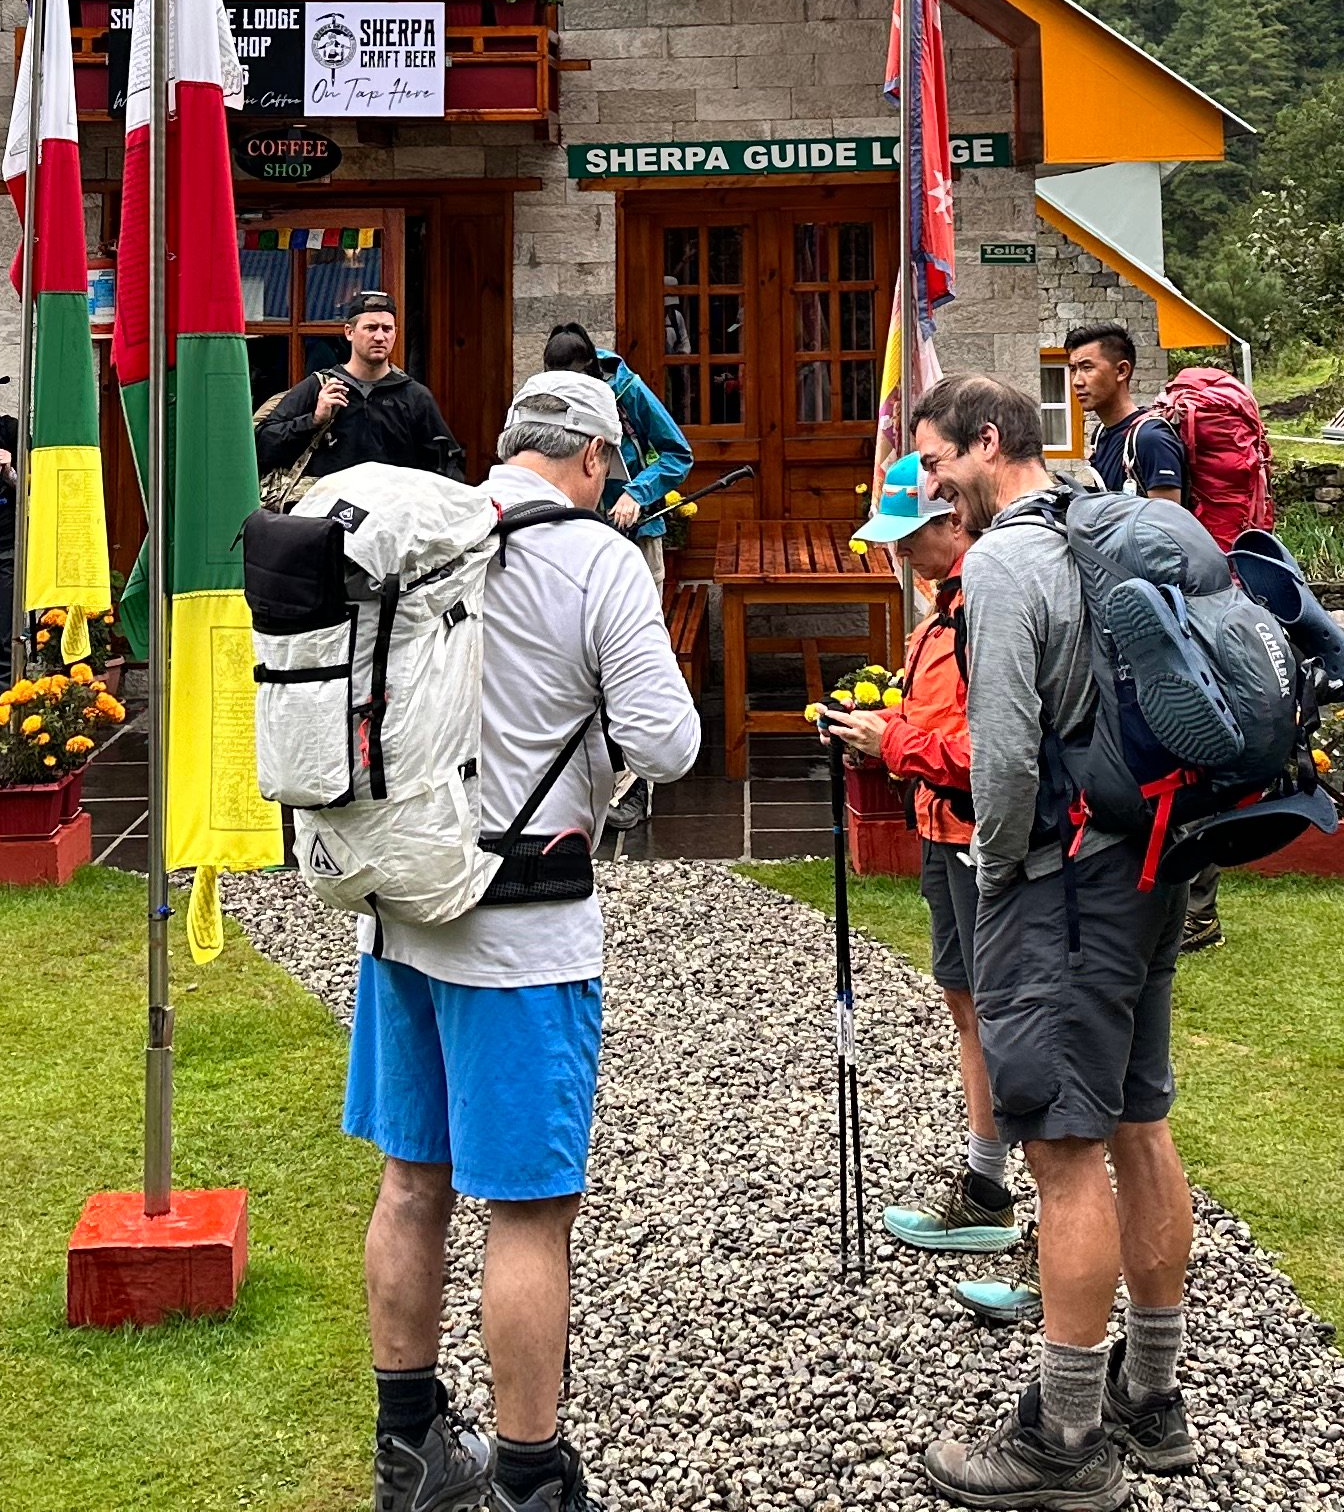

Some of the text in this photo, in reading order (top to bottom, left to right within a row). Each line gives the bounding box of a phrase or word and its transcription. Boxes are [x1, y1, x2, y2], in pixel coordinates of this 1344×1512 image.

[243, 8, 300, 29] LODGE
[359, 19, 435, 47] SHERPA
[360, 50, 436, 68] CRAFT BEER
[312, 77, 435, 111] On Tap Here
[247, 139, 329, 157] COFFEE
[585, 138, 995, 173] SHERPA GUIDE LGE
[263, 163, 312, 177] SHOP
[982, 245, 1034, 255] Toilet
